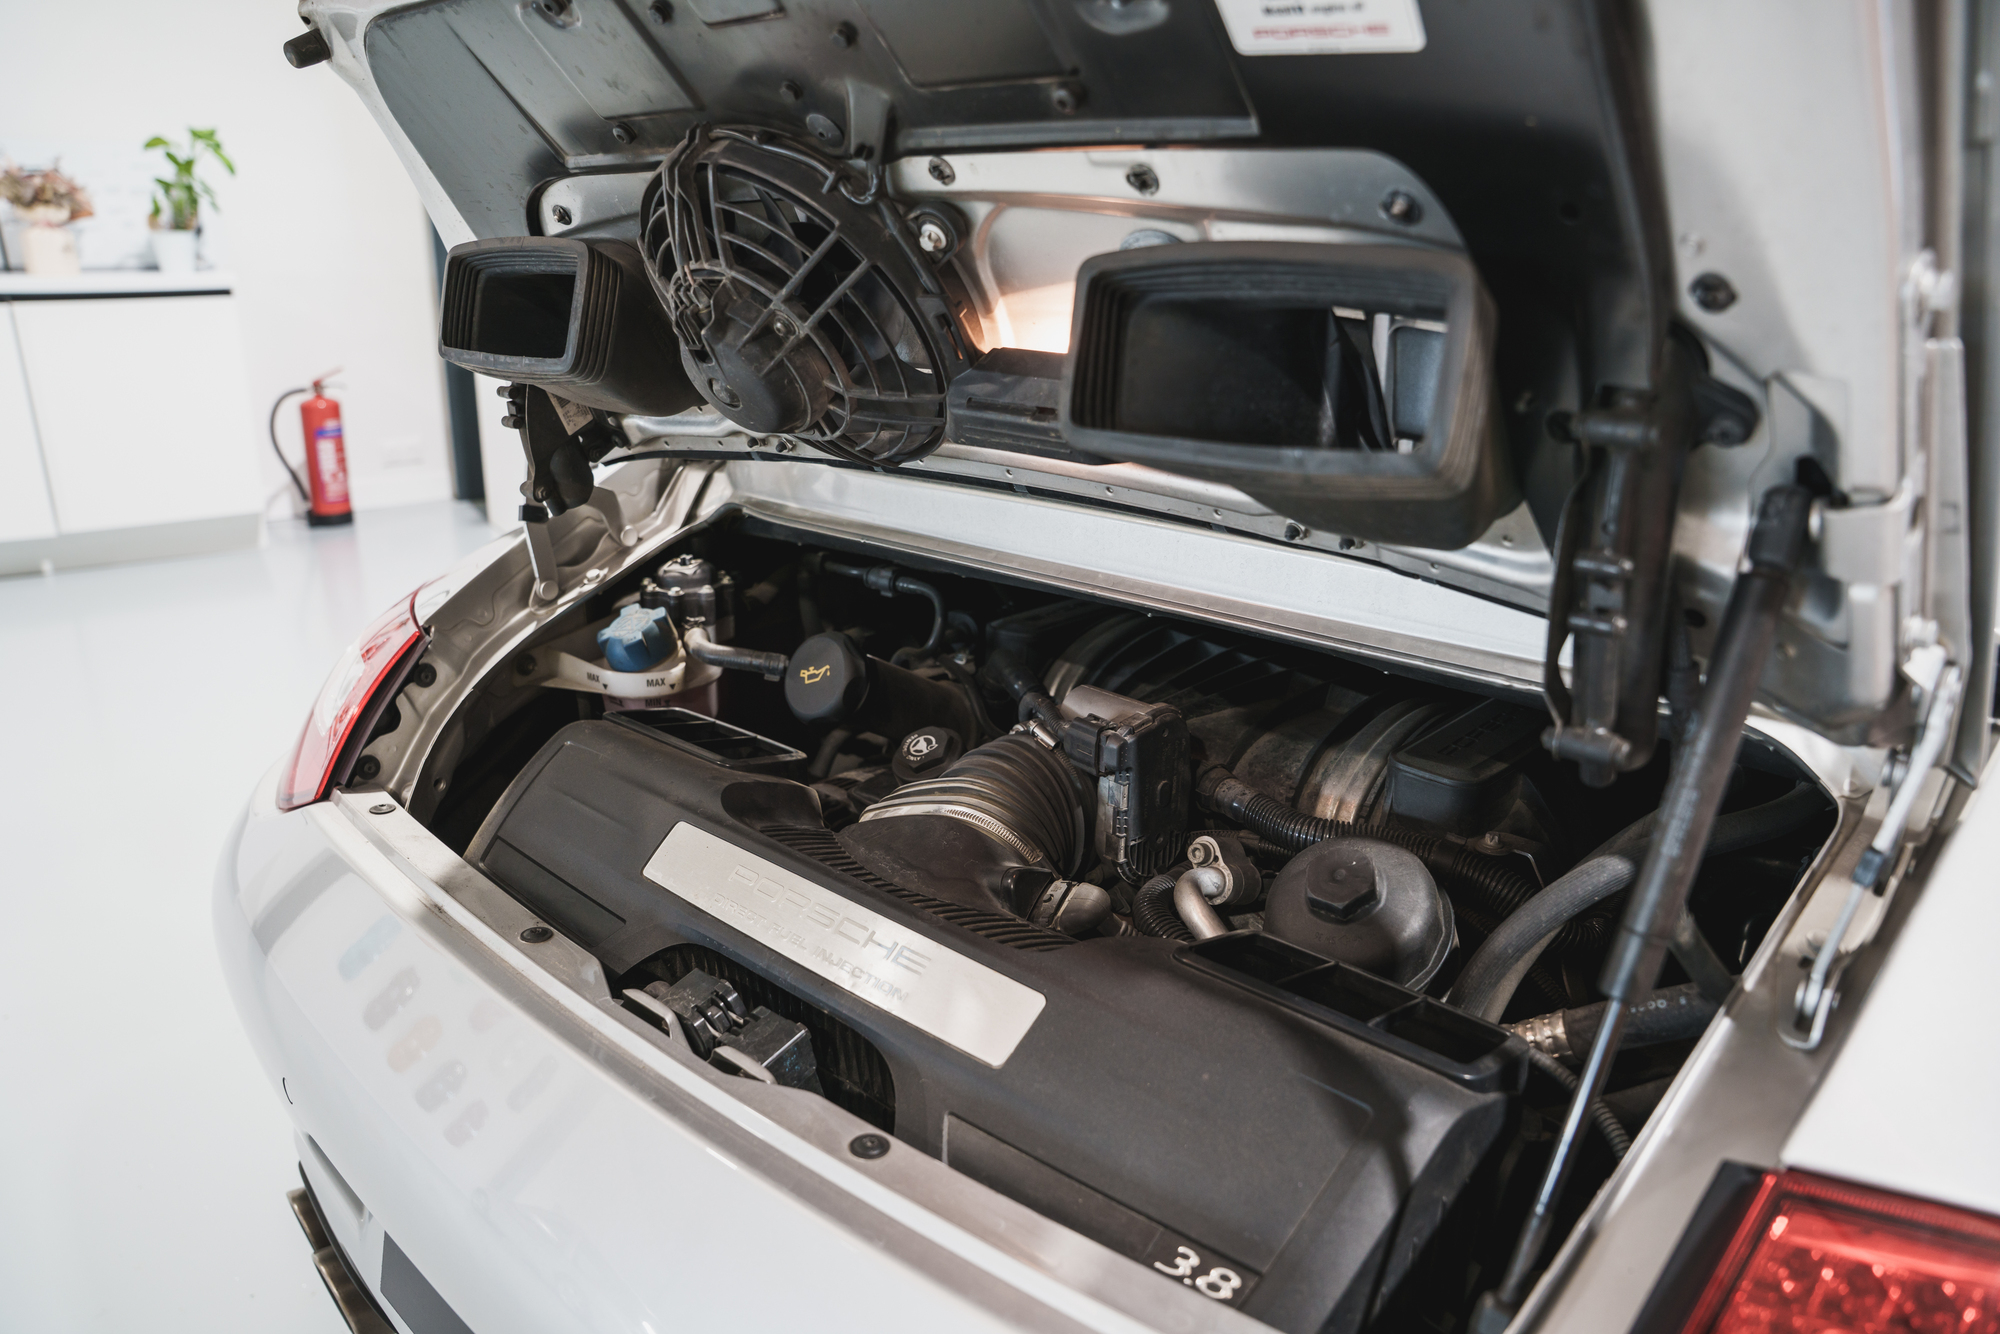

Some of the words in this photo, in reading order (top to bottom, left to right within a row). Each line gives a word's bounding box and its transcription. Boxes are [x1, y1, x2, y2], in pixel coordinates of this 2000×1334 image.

[587, 672, 600, 683] MAX
[646, 677, 666, 687] MAX
[645, 699, 662, 707] MIN
[728, 864, 932, 976] PORSCHE
[713, 893, 768, 928] DIRECT
[768, 922, 808, 950] FUEL
[812, 946, 909, 1001] INJECTION
[1153, 1245, 1242, 1300] 3.8
